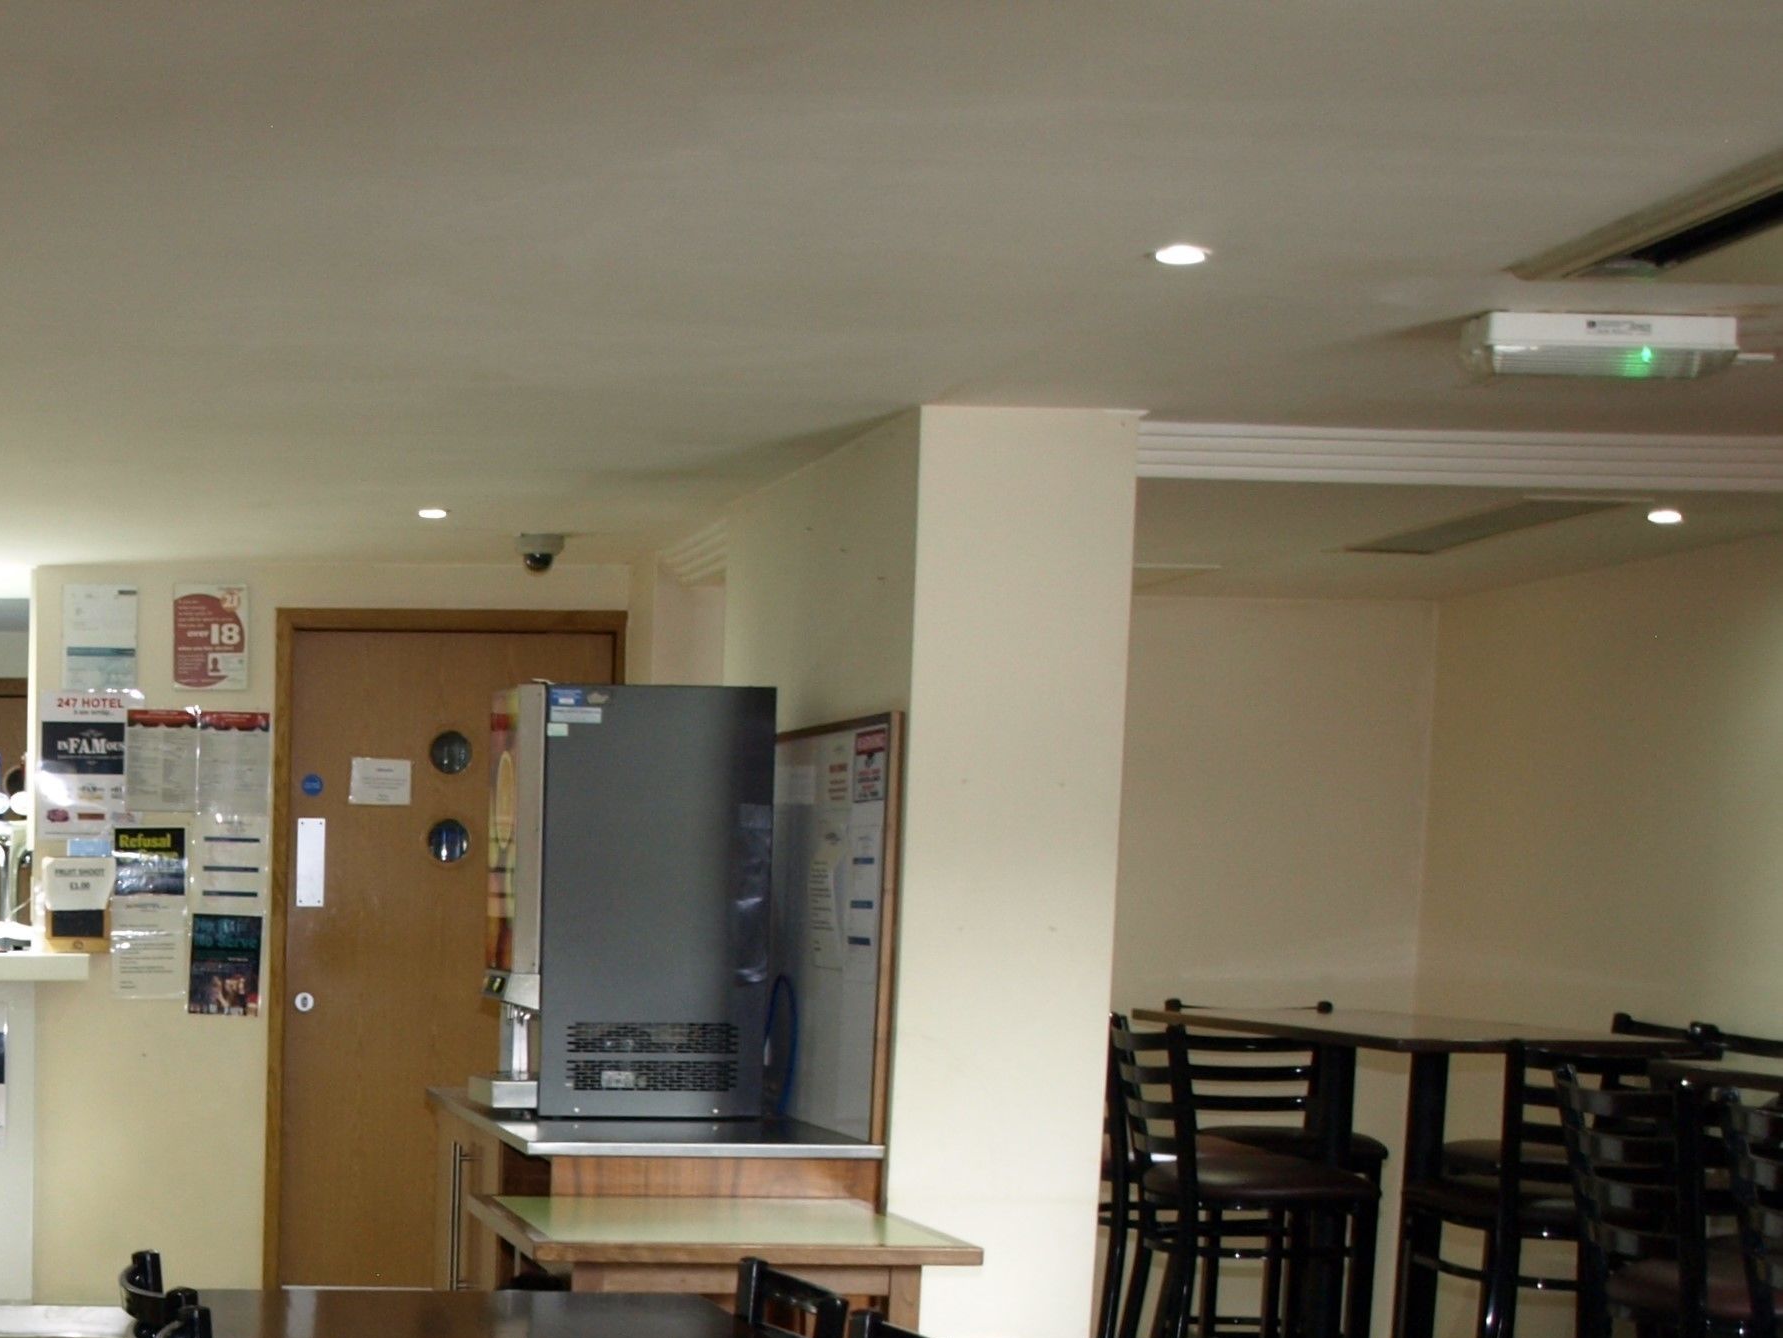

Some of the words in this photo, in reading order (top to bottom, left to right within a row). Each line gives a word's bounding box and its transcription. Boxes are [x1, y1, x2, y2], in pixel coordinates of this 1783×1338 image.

[210, 623, 241, 645] 18
[57, 698, 78, 708] 247
[81, 698, 125, 709] HOTEL
[119, 834, 172, 848] Refusal
[54, 868, 76, 877] FRUIT
[78, 868, 105, 877] SHOOT
